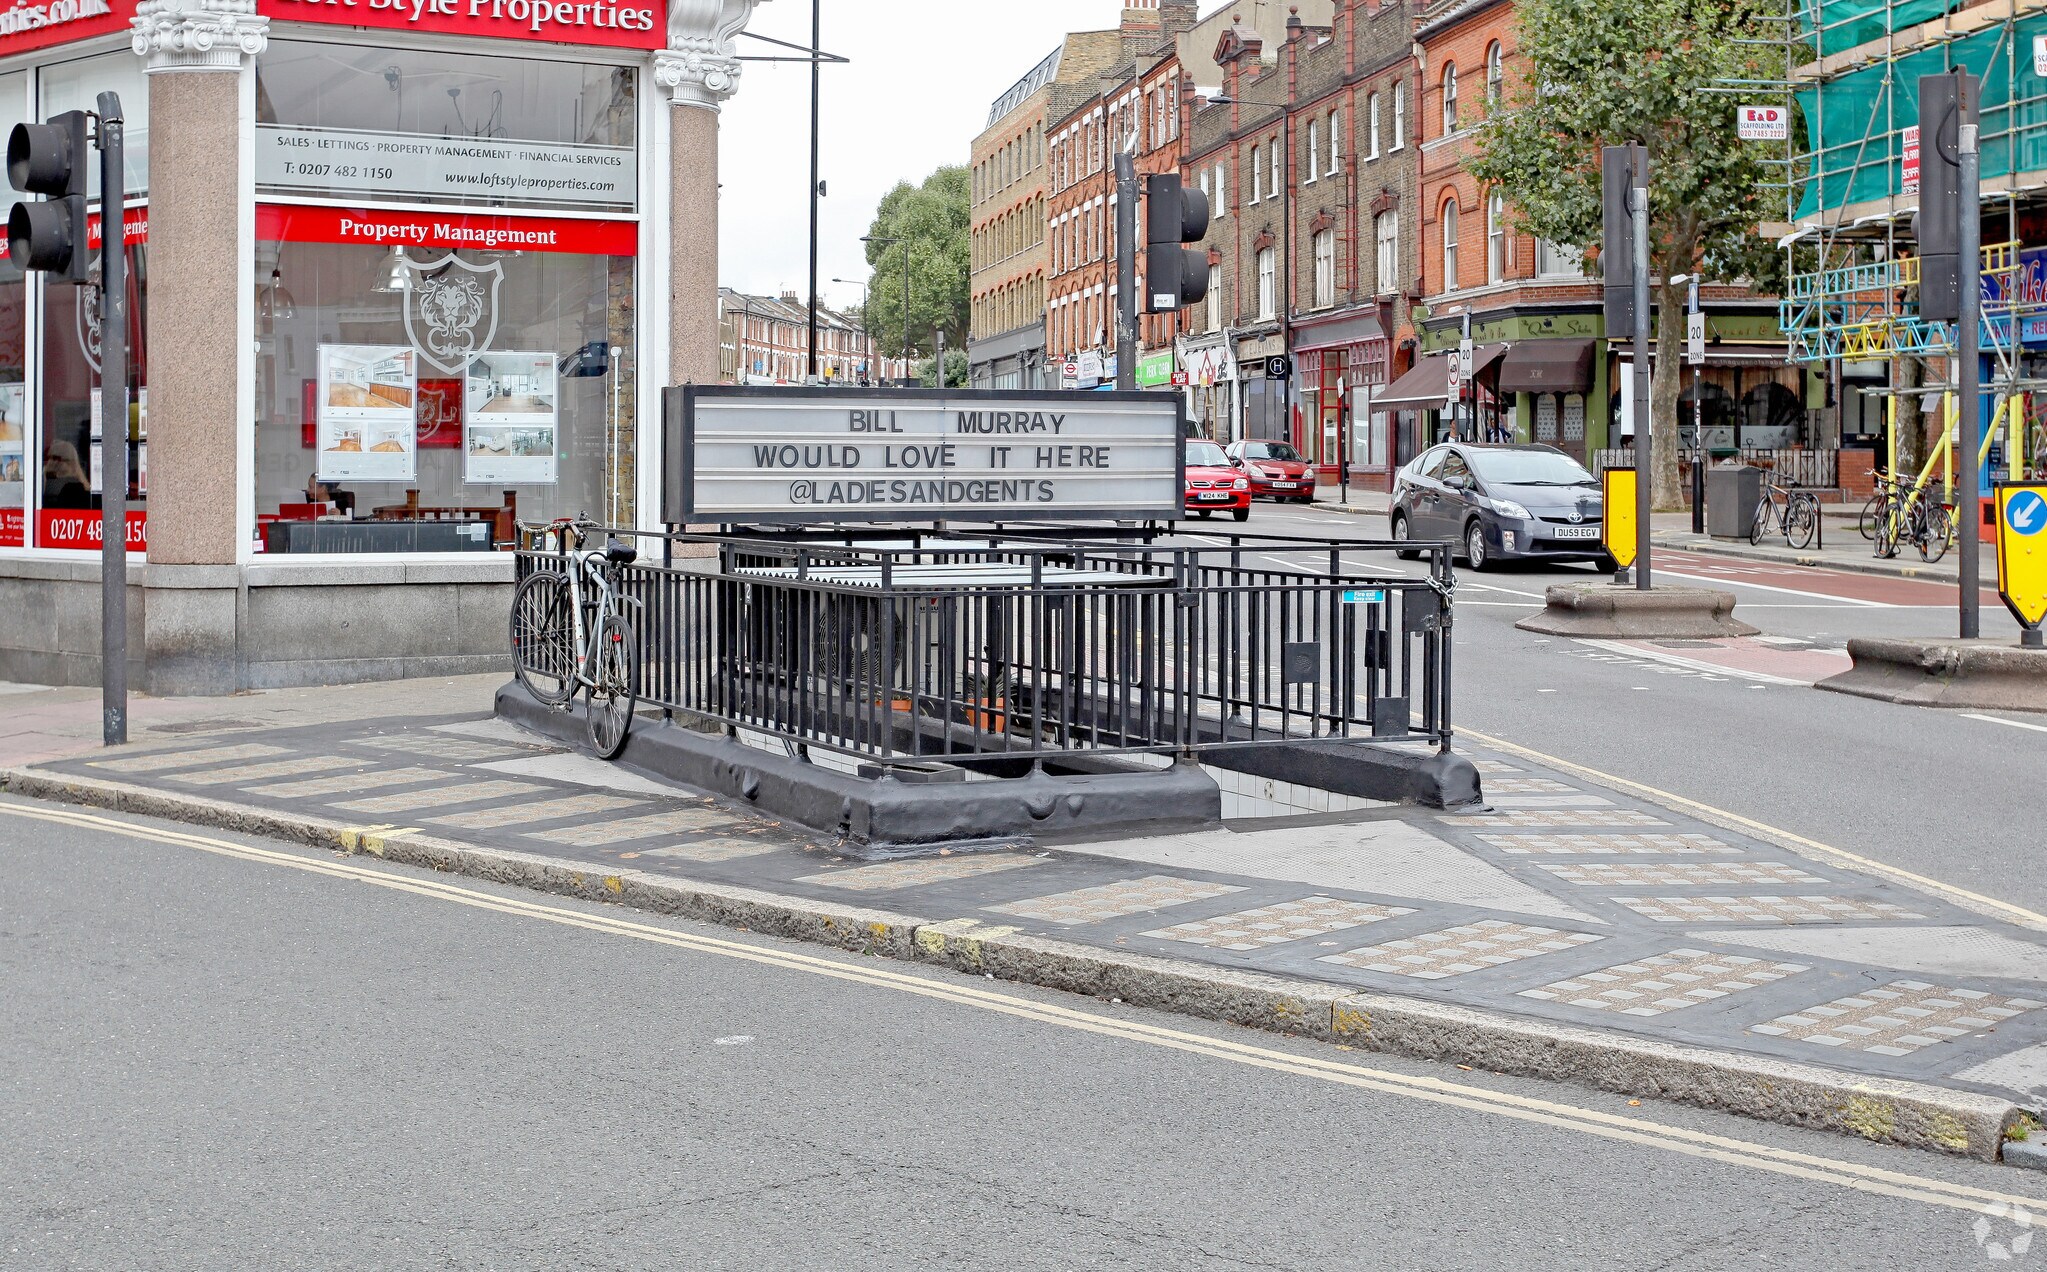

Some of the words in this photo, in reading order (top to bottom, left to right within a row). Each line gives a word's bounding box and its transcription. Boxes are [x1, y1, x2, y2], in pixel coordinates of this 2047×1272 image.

[1740, 122, 1775, 130] SCAFFOLDING
[277, 136, 310, 148] SALES
[317, 139, 370, 151] LETTINGS
[377, 143, 433, 154] PROPERTY
[434, 146, 512, 159] MANAGEMENT
[519, 151, 574, 163] FINANCIAL
[576, 154, 622, 166] SERVICES
[299, 163, 331, 176] 0207
[334, 165, 358, 178] 482
[363, 167, 393, 179] 1150
[445, 172, 615, 191] www.loftstyleproperties.com
[340, 218, 428, 243] Property
[433, 223, 557, 246] Management
[1691, 326, 1701, 340] 20
[1462, 349, 1470, 360] 20
[1690, 352, 1703, 360] ZONE
[1460, 369, 1471, 377] ZONE
[850, 409, 903, 433] BILL
[957, 411, 1066, 434] MURRAY
[753, 444, 861, 469] WOULD
[885, 444, 956, 469] LOVE
[990, 446, 1011, 468] IT
[1036, 445, 1111, 468] HERE
[789, 479, 1054, 504] @LADIESANDGENTS
[51, 518, 84, 540] 0207
[87, 519, 103, 541] 48
[1558, 528, 1579, 537] DU59
[1580, 528, 1597, 537] EGV
